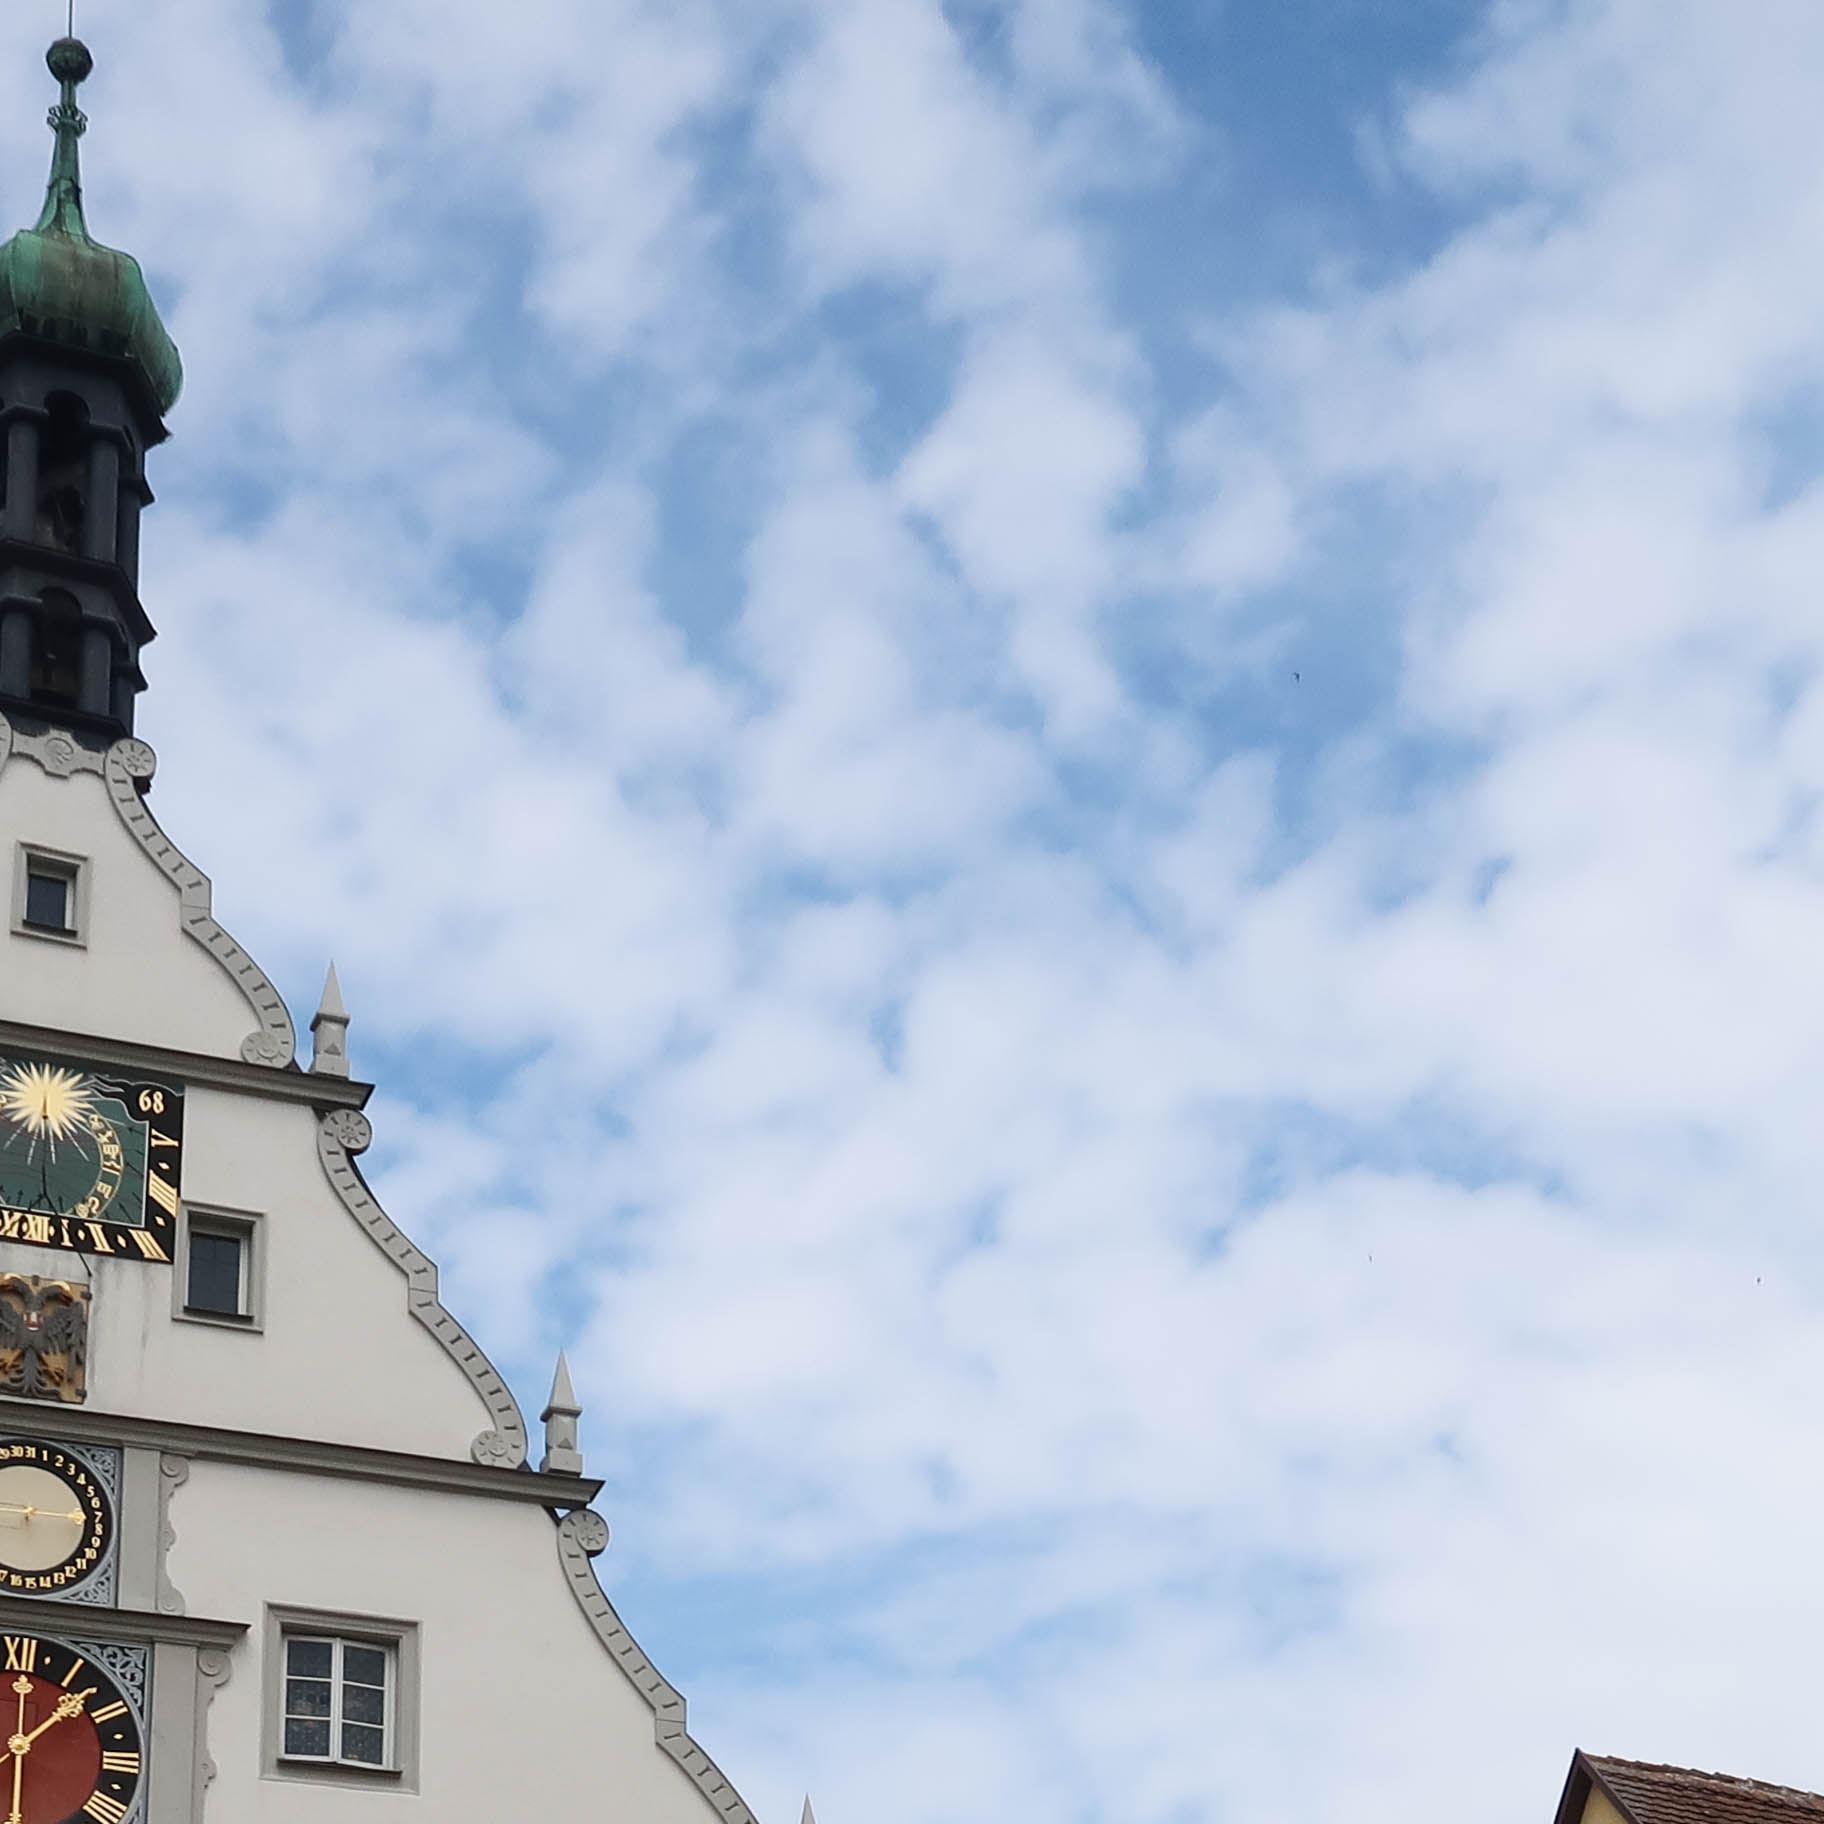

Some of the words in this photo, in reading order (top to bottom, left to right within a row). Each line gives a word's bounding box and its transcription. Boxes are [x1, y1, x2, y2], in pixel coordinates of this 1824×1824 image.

[138, 1089, 165, 1114] 68
[10, 1445, 24, 1458] 30
[25, 1446, 36, 1458] 31
[42, 1450, 49, 1461] 1
[55, 1455, 64, 1467] 2
[66, 1463, 75, 1475] 3
[76, 1473, 86, 1485] 4
[86, 1485, 95, 1497] 5
[91, 1497, 101, 1508] 6
[94, 1511, 103, 1523] 7
[95, 1523, 103, 1535] 8
[91, 1536, 101, 1548] 9
[84, 1547, 97, 1559] 10
[75, 1558, 87, 1570] 11
[64, 1566, 77, 1577] 12
[53, 1572, 65, 1584] 13
[4, 1636, 38, 1672] XII
[61, 1658, 84, 1687] I
[91, 1700, 128, 1724] II
[102, 1751, 140, 1774] III
